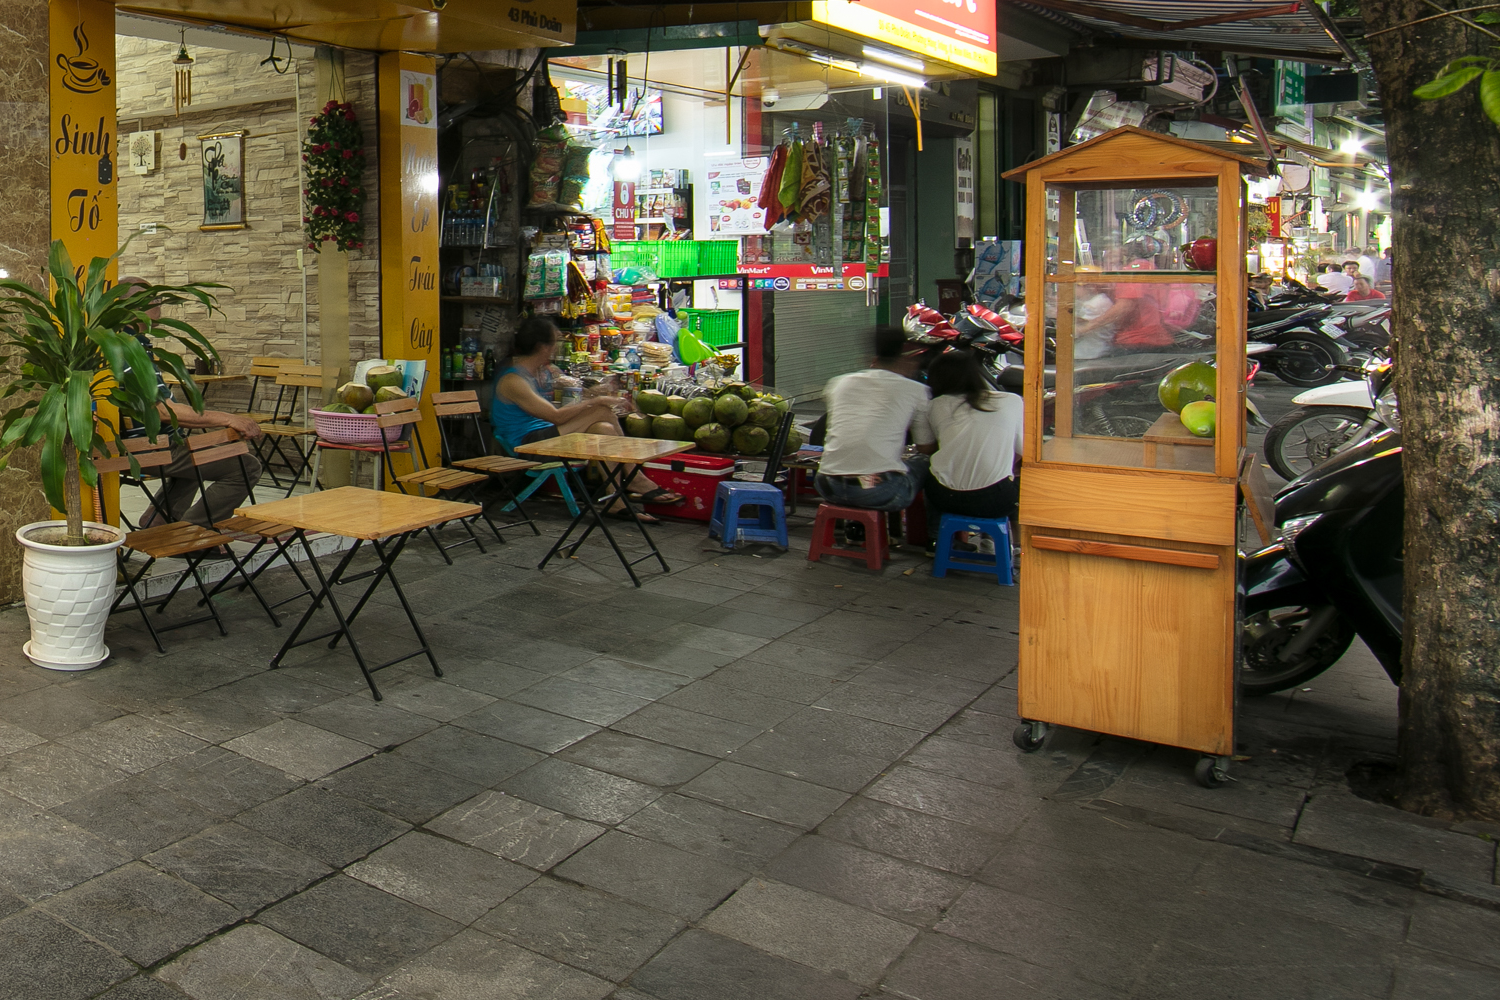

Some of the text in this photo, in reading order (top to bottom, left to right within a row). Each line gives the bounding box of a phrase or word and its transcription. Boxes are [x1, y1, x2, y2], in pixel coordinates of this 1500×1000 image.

[508, 7, 519, 22] 43
[897, 92, 930, 111] COEE
[55, 113, 112, 157] Sinh
[67, 188, 103, 233] Tố
[615, 206, 635, 219] CHÚ Ý
[410, 317, 435, 355] Cây
